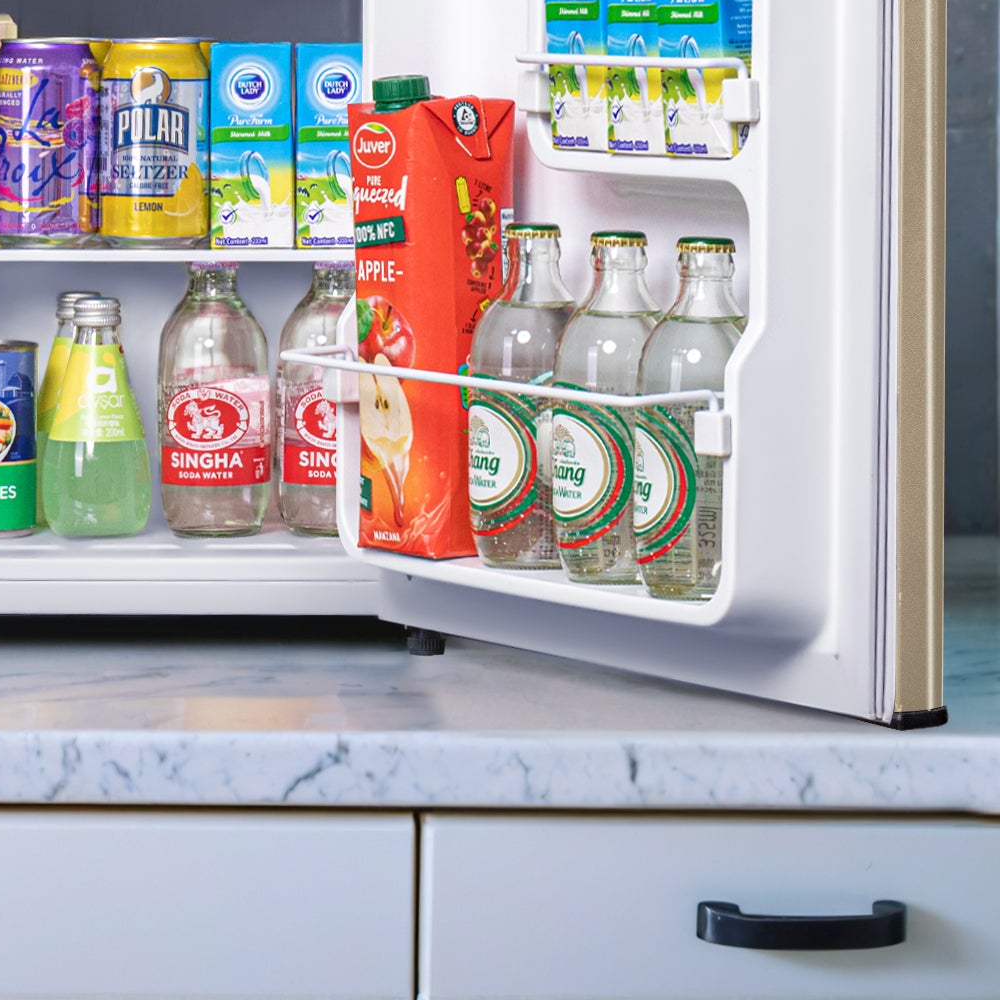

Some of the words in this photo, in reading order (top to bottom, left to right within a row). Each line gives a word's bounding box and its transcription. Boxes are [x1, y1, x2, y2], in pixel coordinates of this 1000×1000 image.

[240, 87, 260, 95] LADY
[327, 87, 347, 95] LADY
[12, 78, 64, 147] La
[313, 114, 349, 126] PureFa
[117, 108, 185, 146] POLAR
[357, 137, 390, 154] Juver
[366, 175, 382, 186] PURE
[353, 175, 408, 214] queezed
[134, 202, 163, 212] LEMON
[356, 224, 376, 243] 00%
[376, 221, 395, 240] NFC
[171, 392, 191, 409] SODA
[214, 392, 245, 410] WATER
[300, 391, 323, 408] SODA
[170, 451, 243, 469] SINGHA
[178, 471, 201, 479] SODA
[202, 471, 234, 480] WATER
[307, 470, 332, 478] SODA
